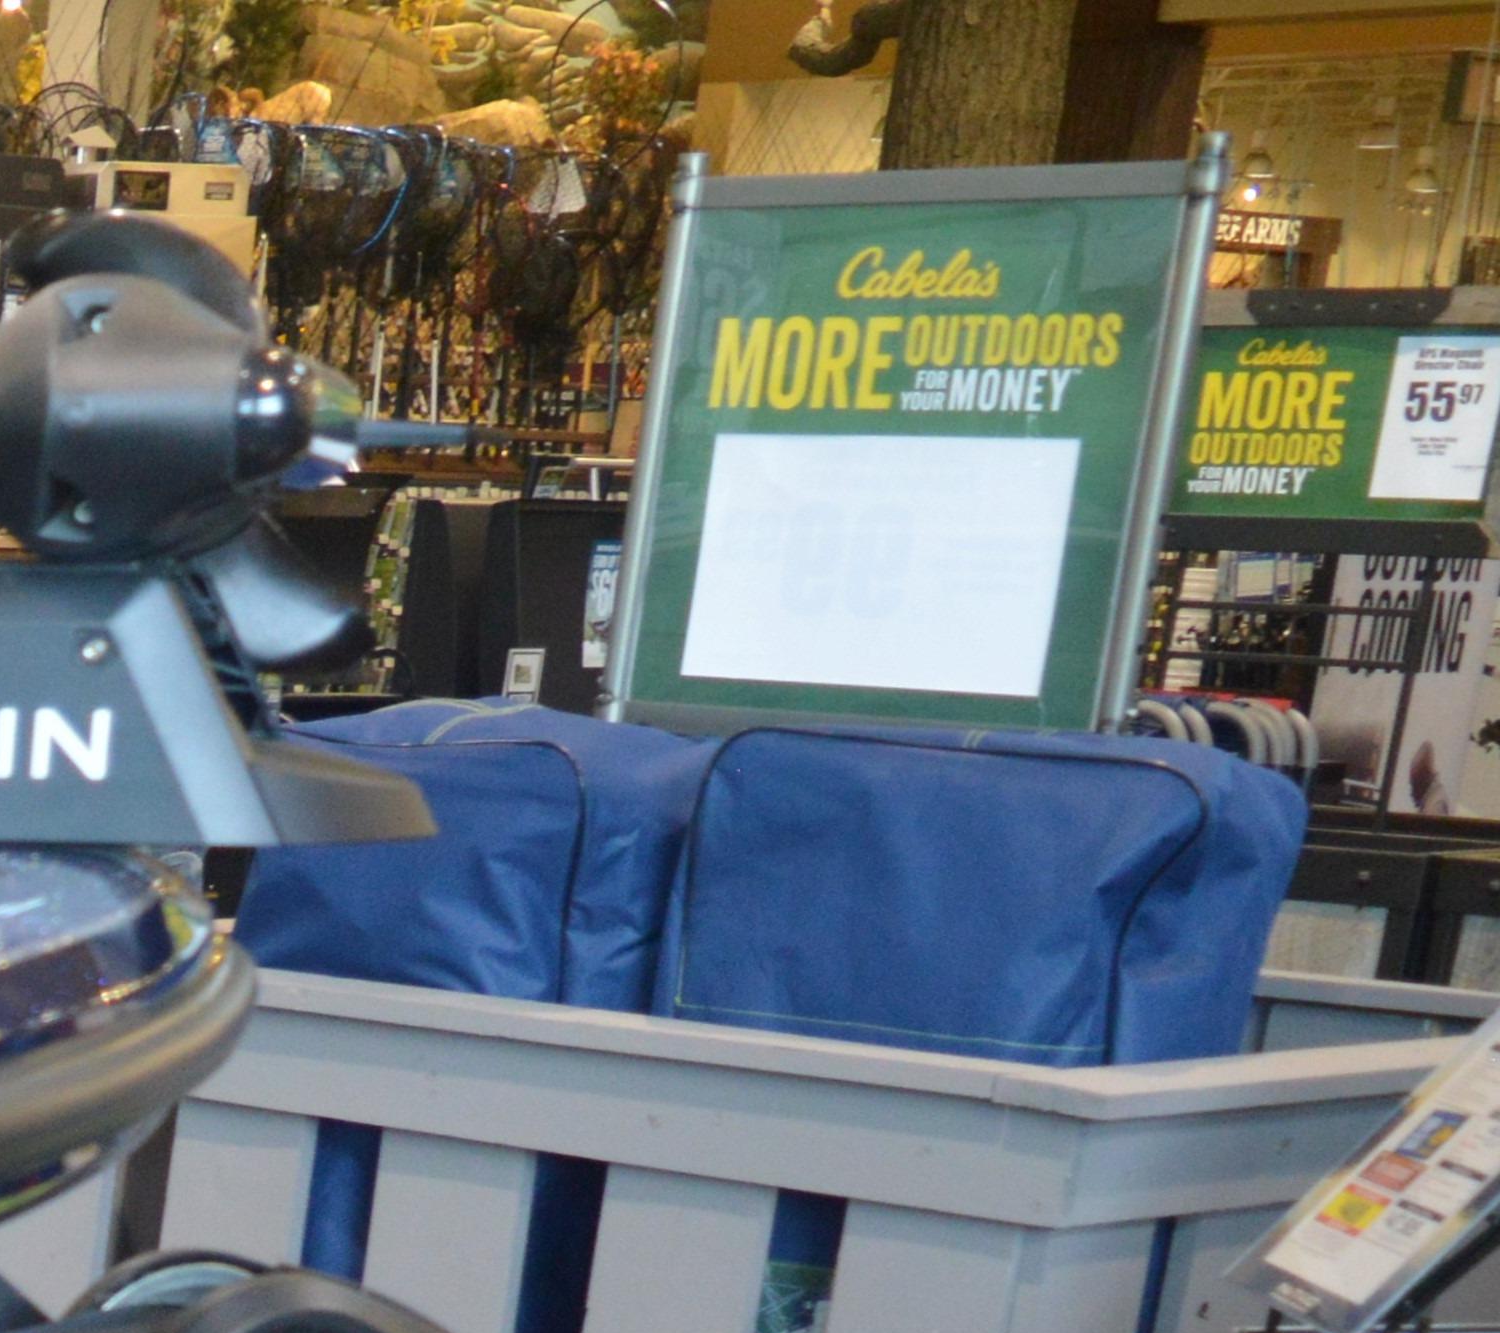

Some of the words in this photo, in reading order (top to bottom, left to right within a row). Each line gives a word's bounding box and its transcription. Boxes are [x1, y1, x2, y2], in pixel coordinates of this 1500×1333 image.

[837, 246, 1000, 298] Cabela's
[708, 315, 904, 410] MORE
[903, 312, 1124, 367] OUTDOORS
[1238, 338, 1327, 365] Cabela's
[915, 369, 949, 390] FOR
[900, 391, 946, 411] YOUR
[1197, 371, 1355, 429] MORE
[1189, 432, 1344, 466] OUTDOORS
